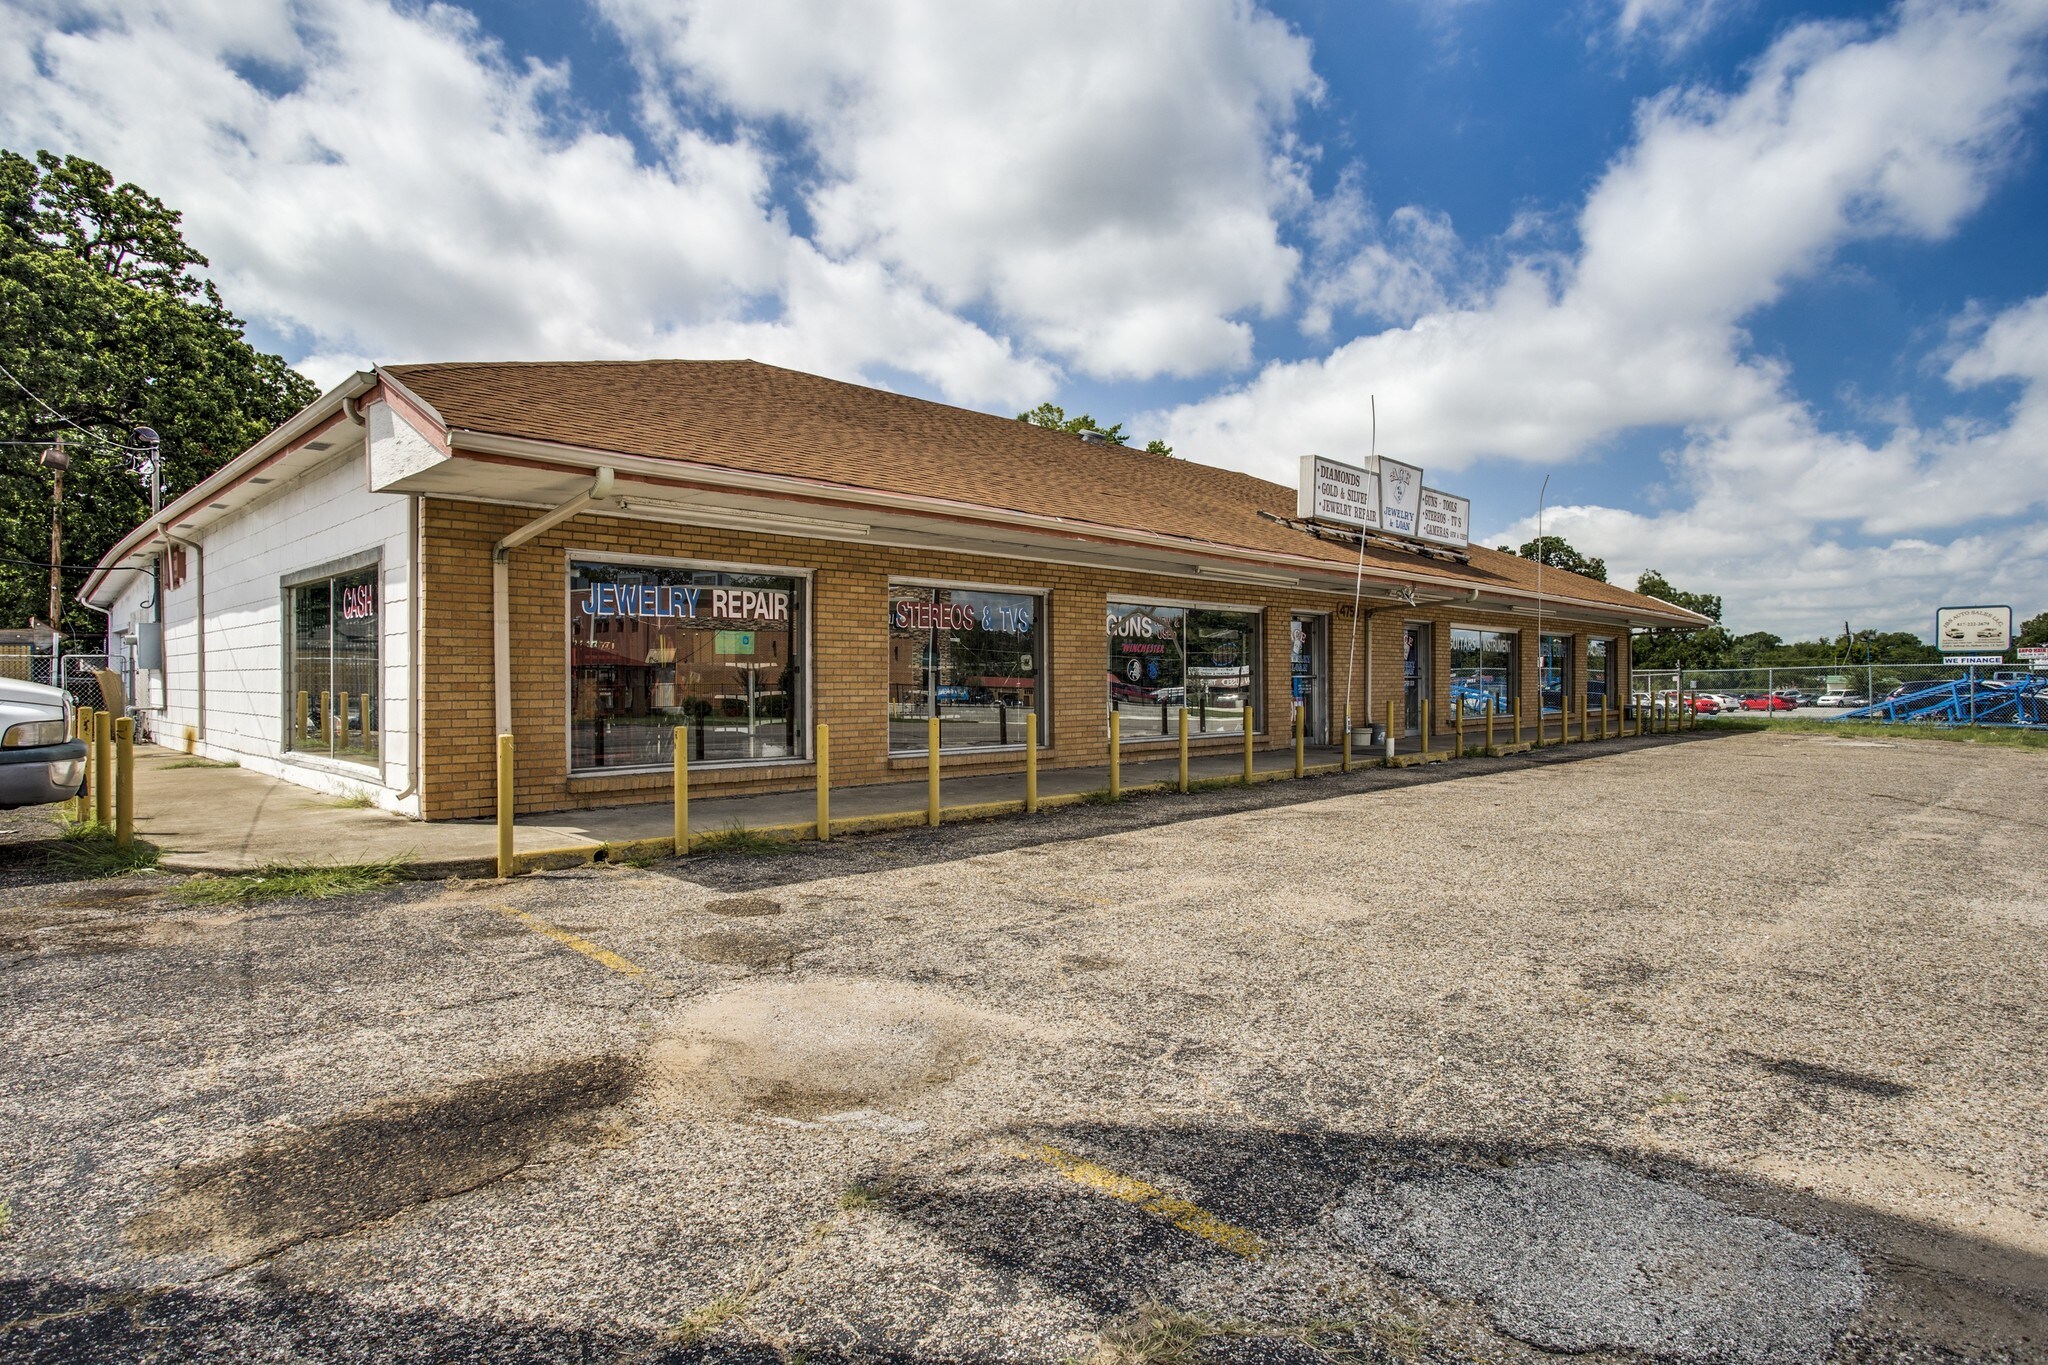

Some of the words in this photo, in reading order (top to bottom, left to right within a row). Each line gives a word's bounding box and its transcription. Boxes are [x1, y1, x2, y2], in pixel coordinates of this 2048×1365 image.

[1320, 465, 1360, 487] DIAMONDS
[1390, 467, 1411, 486] ACE
[1321, 482, 1338, 497] GOLD
[1340, 487, 1345, 499] &
[1322, 499, 1352, 517] JEWELRY
[1354, 506, 1377, 522] REPAIR
[1424, 494, 1438, 508] GUNS
[1442, 499, 1457, 513] TOOLS
[1384, 506, 1414, 521] JEWELRY
[1424, 509, 1446, 524] STEREOS
[1389, 519, 1394, 527] &
[1395, 519, 1410, 531] LOAN
[1426, 523, 1449, 539] CAMERAS
[343, 584, 373, 619] CASH
[581, 582, 702, 619] JEWELRY
[712, 589, 789, 620] REPAIR
[896, 600, 975, 631] STEREOS
[982, 605, 994, 632] &
[1000, 606, 1029, 633] TVS
[1953, 611, 1970, 620] AUTO
[1971, 610, 1993, 618] SALES
[1106, 614, 1152, 638] GUNS
[1121, 643, 1165, 654] WINCHESTER
